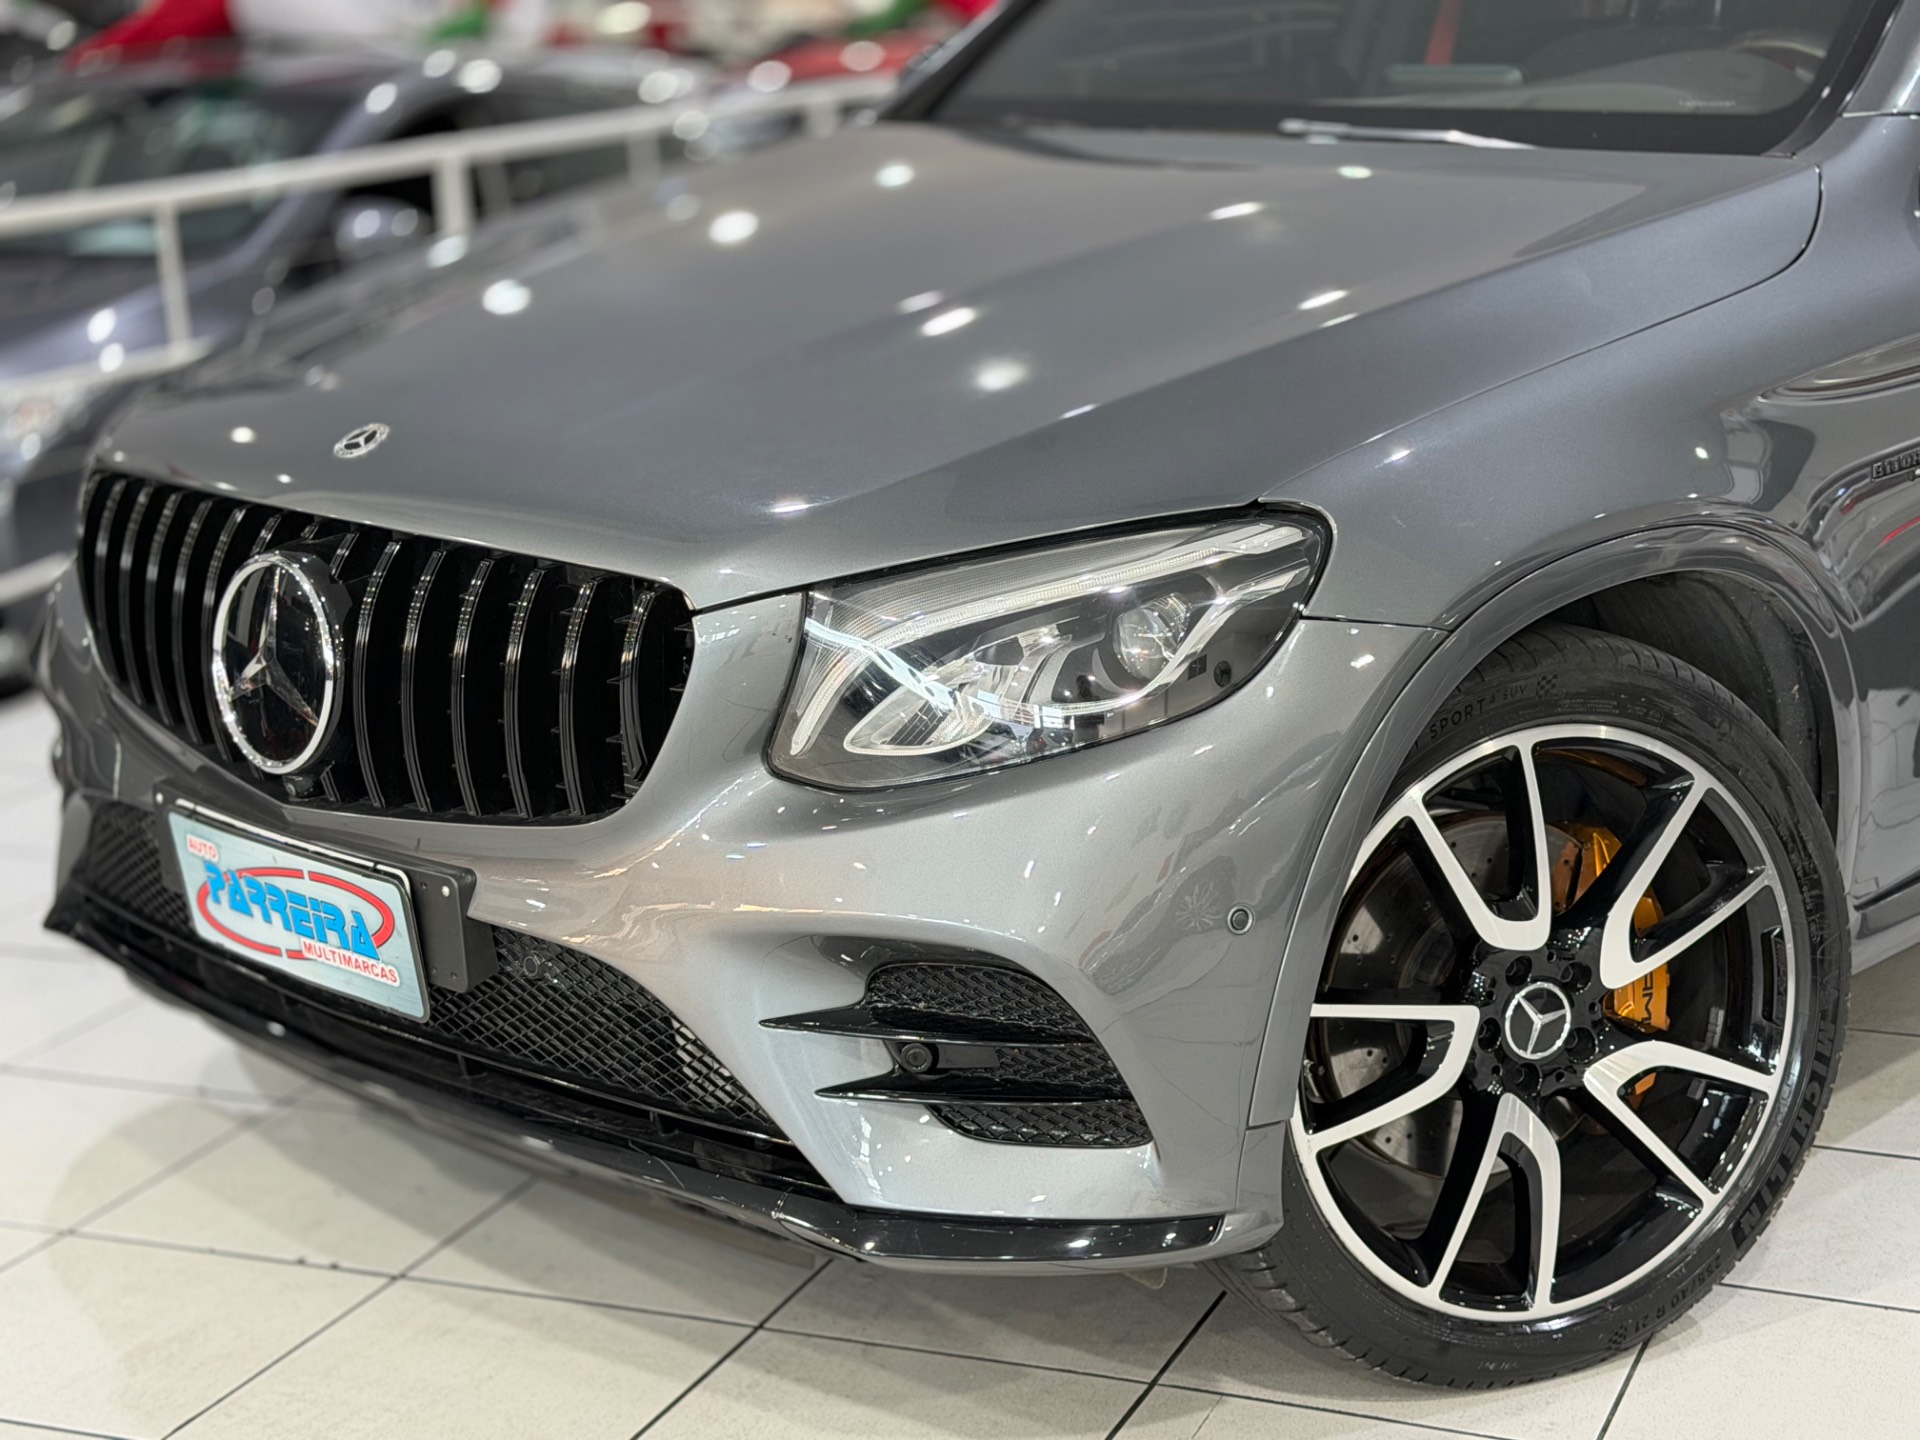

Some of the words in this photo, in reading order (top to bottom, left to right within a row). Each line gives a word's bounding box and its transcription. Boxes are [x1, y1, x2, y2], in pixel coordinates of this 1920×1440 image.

[1429, 697, 1487, 740] SPORT
[1502, 683, 1528, 699] SUV
[187, 837, 218, 859] AUTO
[203, 860, 381, 961] PARREIRA
[302, 941, 398, 984] MULTIMARCAS
[1741, 1020, 1836, 1232] MICHELIN
[1670, 1253, 1721, 1309] 255/40
[1634, 1314, 1649, 1333] 21
[1656, 1305, 1666, 1319] R
